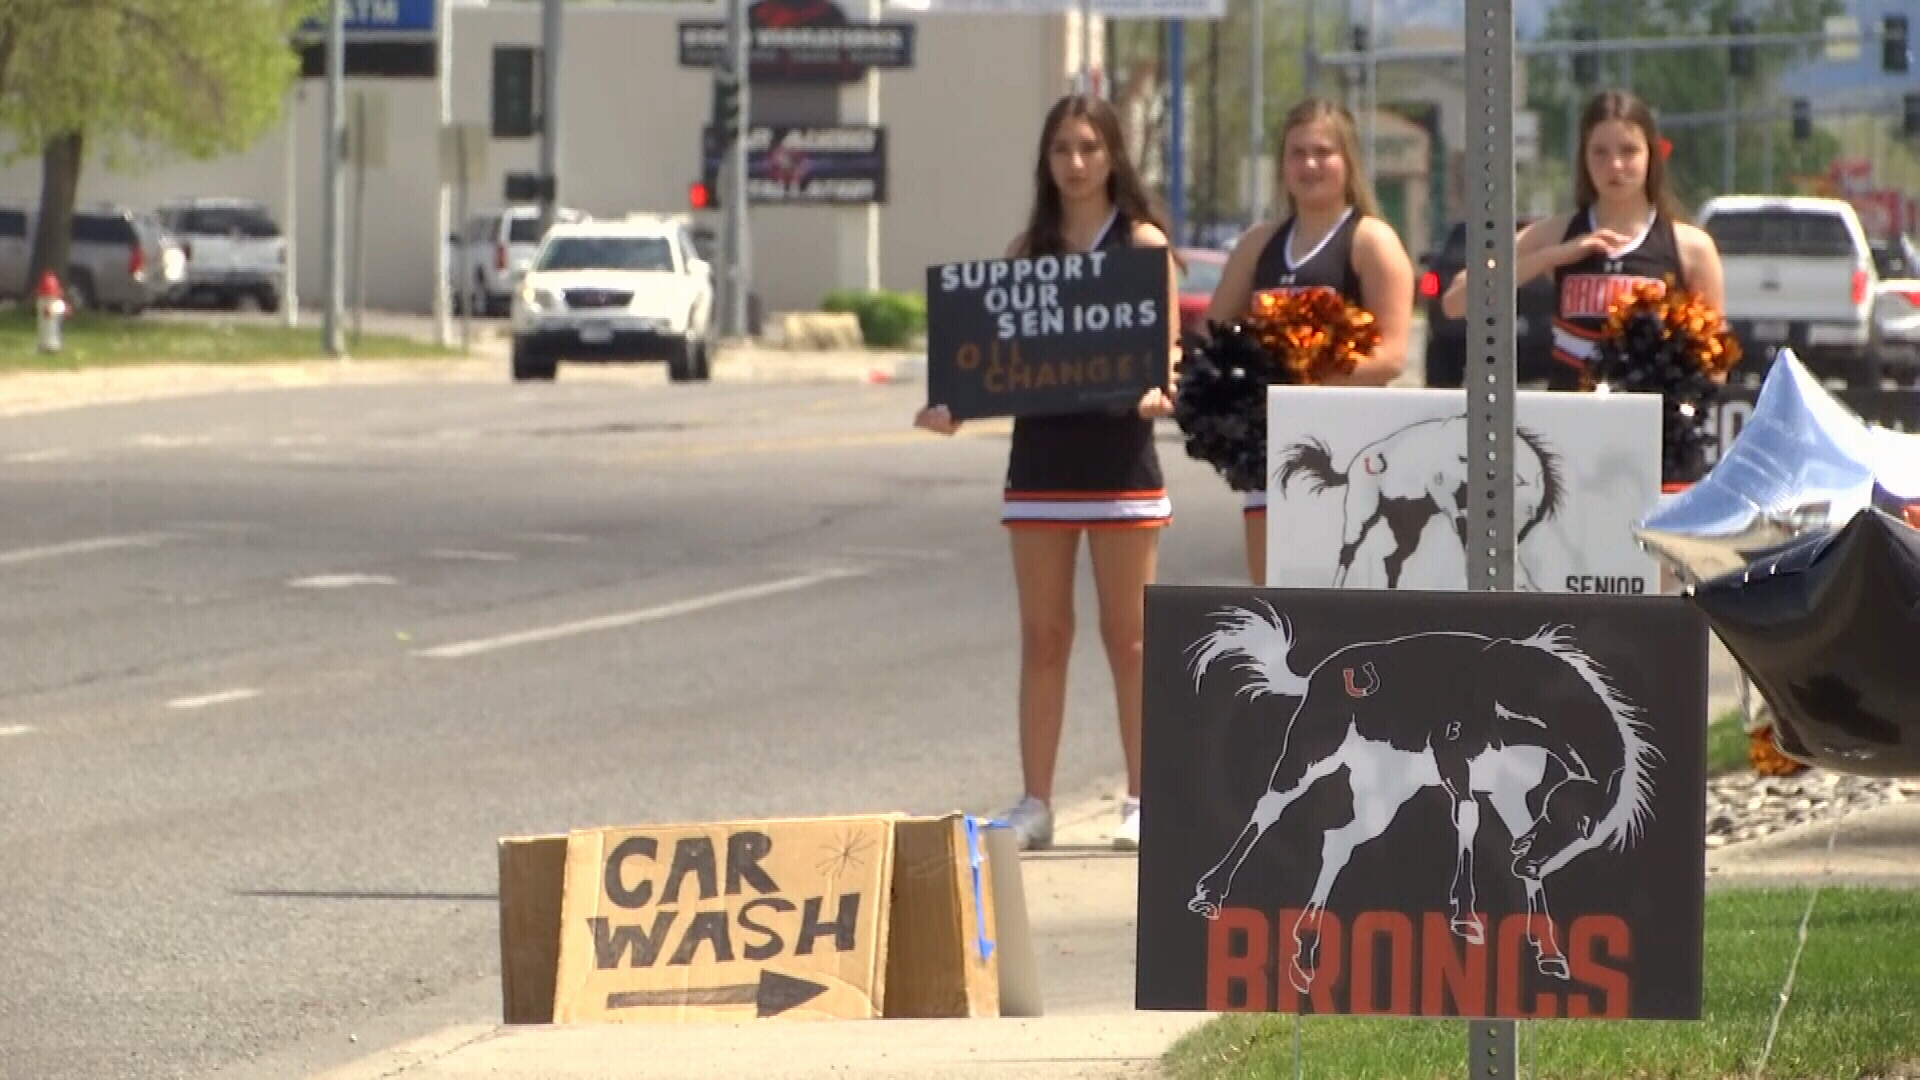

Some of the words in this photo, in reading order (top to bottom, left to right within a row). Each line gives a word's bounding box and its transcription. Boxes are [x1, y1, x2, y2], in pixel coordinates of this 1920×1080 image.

[940, 252, 1107, 292] SUPPORT
[984, 283, 1059, 315] OUR
[997, 300, 1158, 340] SENIORS
[1566, 575, 1645, 595] SENIOR
[604, 831, 780, 909] CAR
[586, 892, 860, 970] WASH
[1206, 906, 1634, 1018] BRONCS
